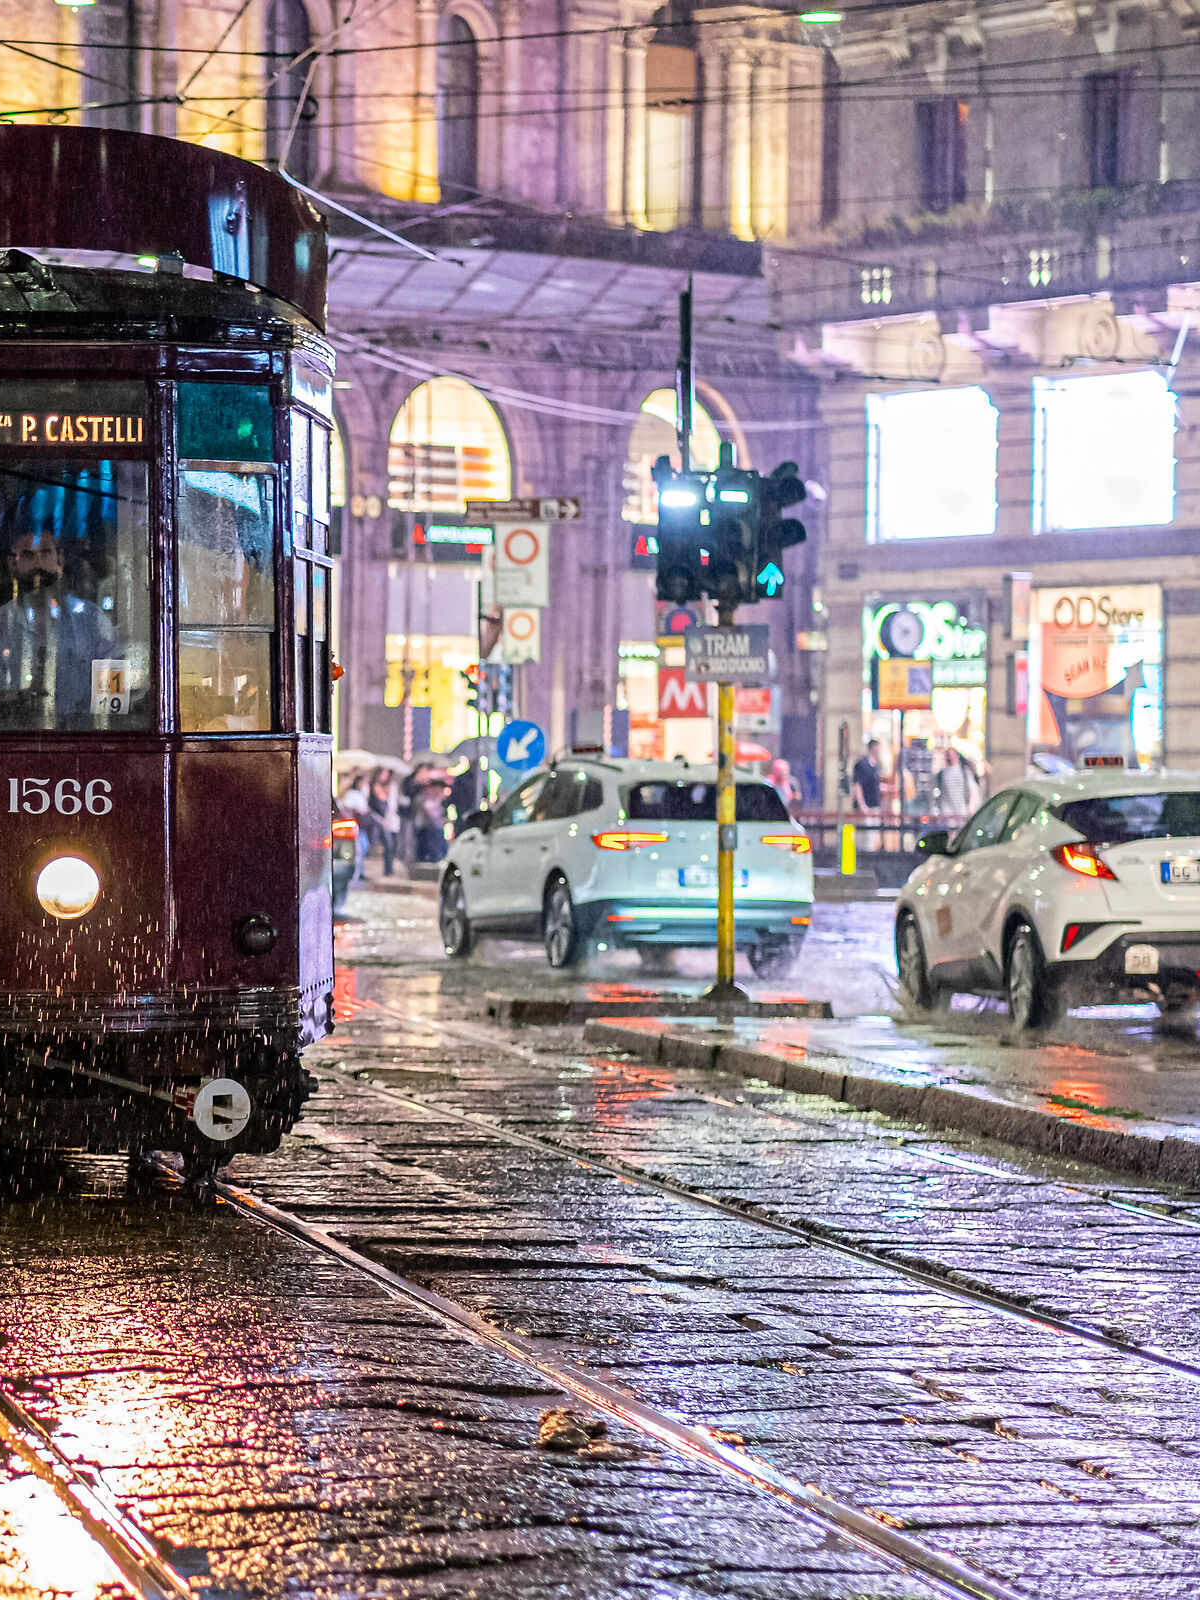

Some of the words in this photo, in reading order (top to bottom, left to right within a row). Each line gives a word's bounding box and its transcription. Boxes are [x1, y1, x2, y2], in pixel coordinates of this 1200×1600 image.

[22, 416, 37, 442] P.
[45, 415, 143, 442] CASTELLI
[704, 634, 749, 656] TRAM
[8, 778, 113, 816] 1566
